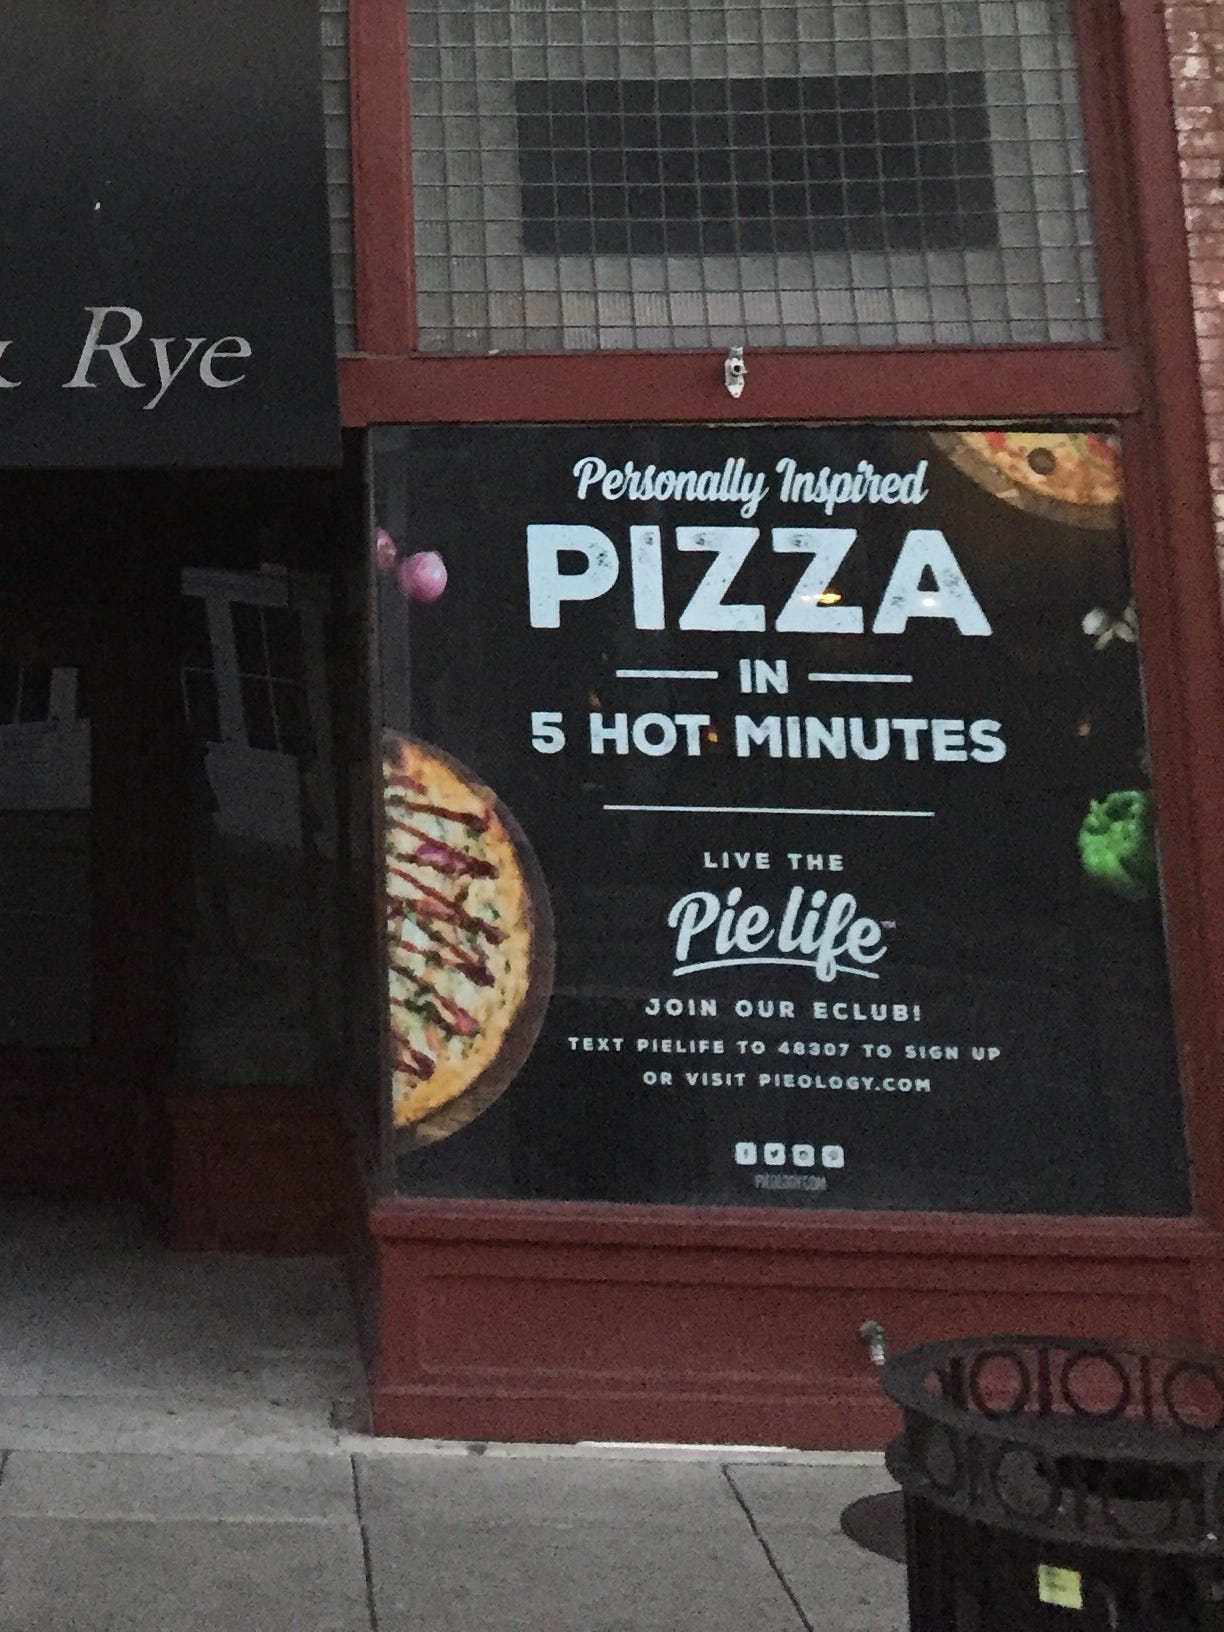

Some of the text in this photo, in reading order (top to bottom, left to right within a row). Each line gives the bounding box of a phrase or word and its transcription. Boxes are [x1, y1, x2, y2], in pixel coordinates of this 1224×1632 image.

[61, 305, 253, 410] Rye
[572, 456, 929, 519] Personally Inspired
[526, 524, 993, 637] PIZZA
[739, 658, 789, 695] IN
[530, 711, 1007, 763] 5 HOT MINUTES
[703, 851, 844, 872] LIVE THE
[645, 998, 921, 1022] JOIN OUR ECLUB!
[567, 1036, 1001, 1062] TEXT PIELIFE TO 48307 TO SIGN UP
[642, 1071, 931, 1092] OR VISIT PIEOLOGY.COM
